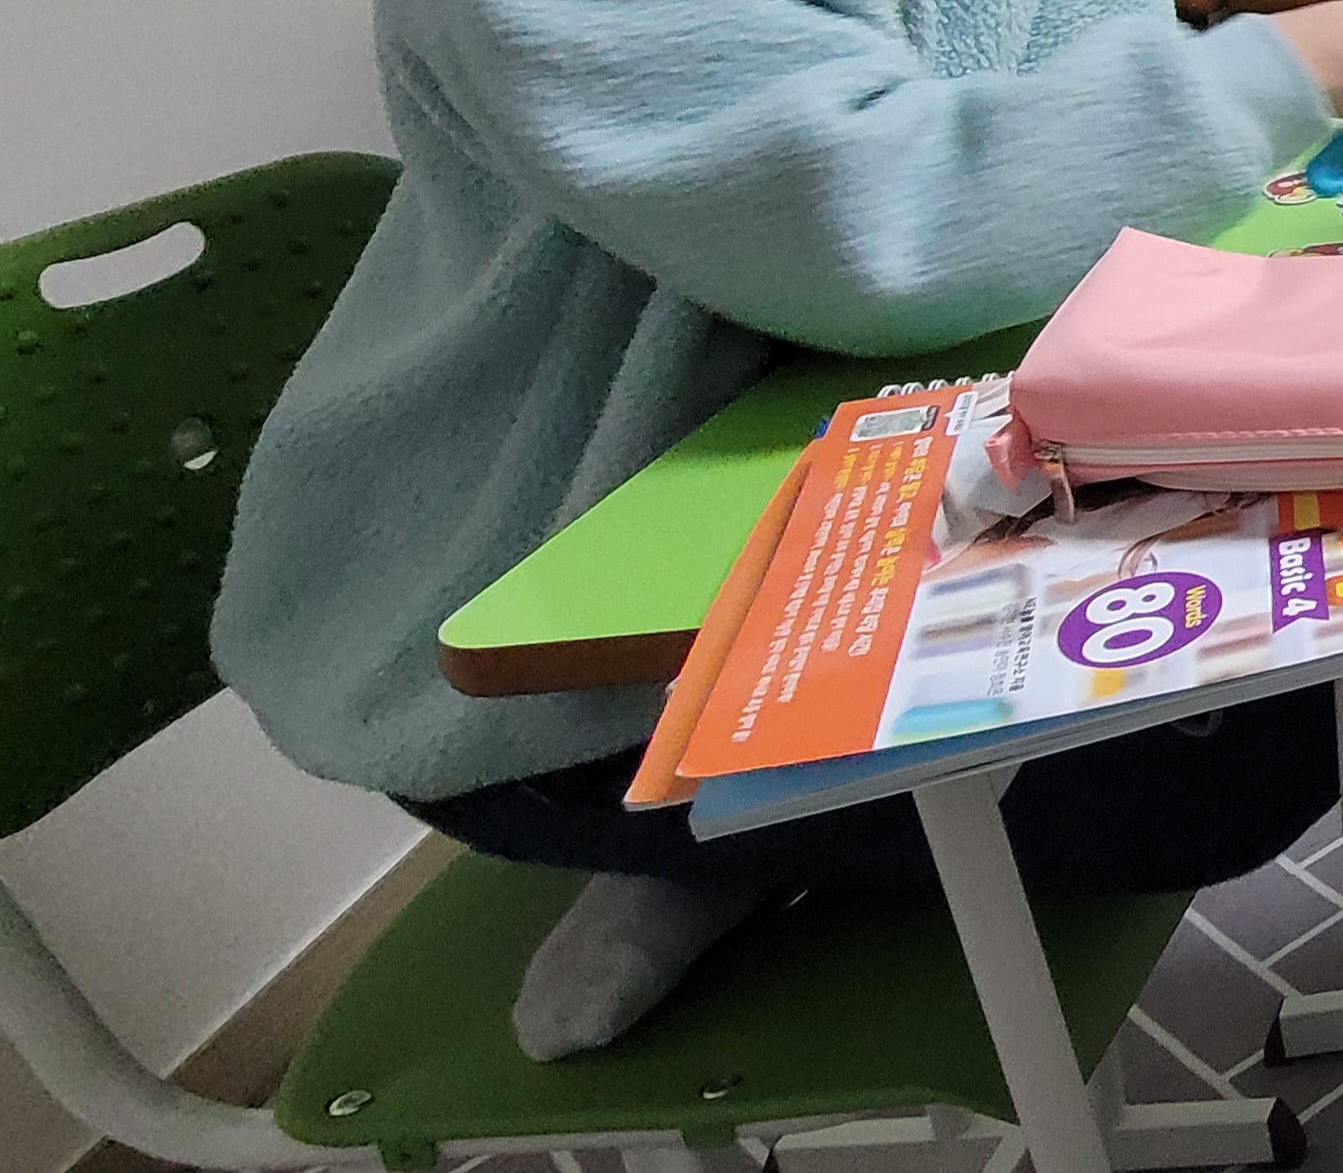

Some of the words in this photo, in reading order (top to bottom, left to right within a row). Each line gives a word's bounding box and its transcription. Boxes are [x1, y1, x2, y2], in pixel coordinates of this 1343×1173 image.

[1278, 537, 1314, 595] Basic
[1082, 579, 1176, 663] 80
[1183, 583, 1208, 630] Words
[1281, 597, 1317, 618] 4
